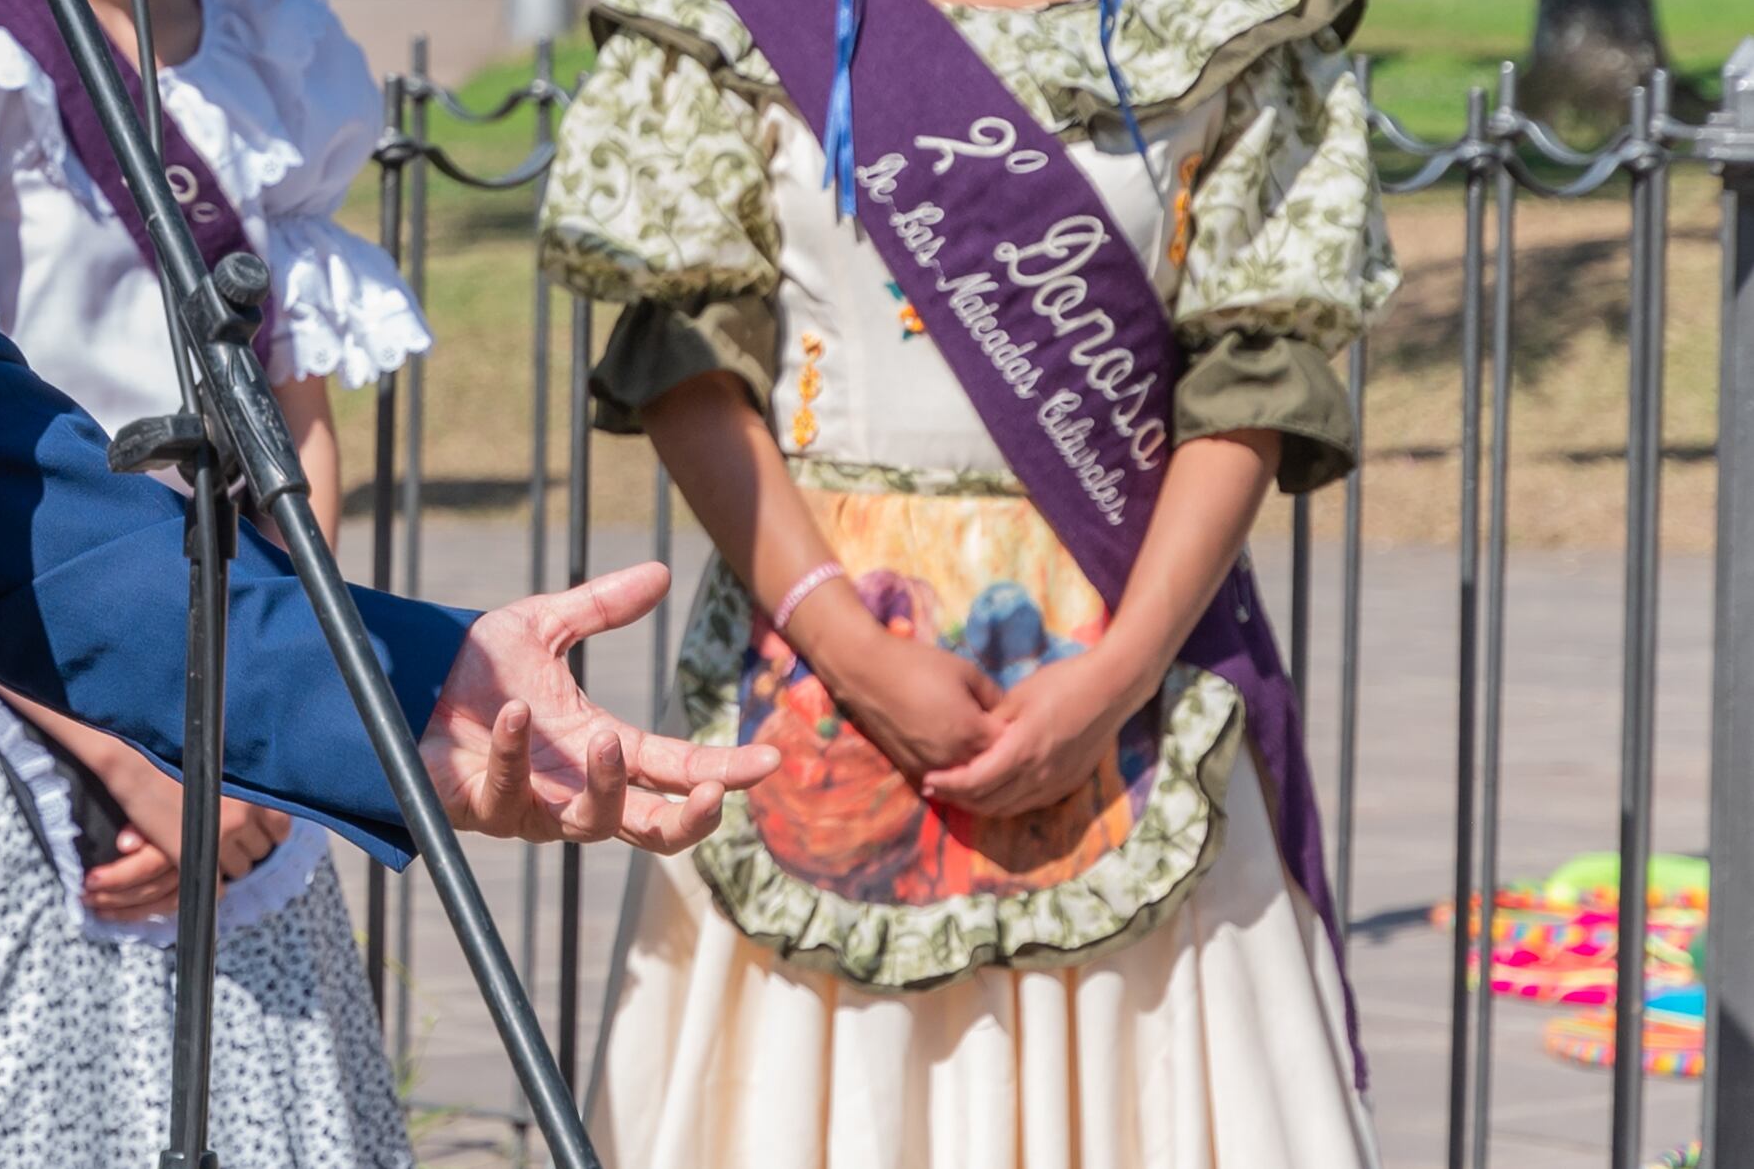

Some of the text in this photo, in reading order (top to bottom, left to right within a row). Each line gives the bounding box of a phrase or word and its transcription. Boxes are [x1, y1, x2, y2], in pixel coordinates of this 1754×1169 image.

[854, 152, 1128, 526] De Las Mateadas Culturales
[993, 214, 1167, 471] Donosa
